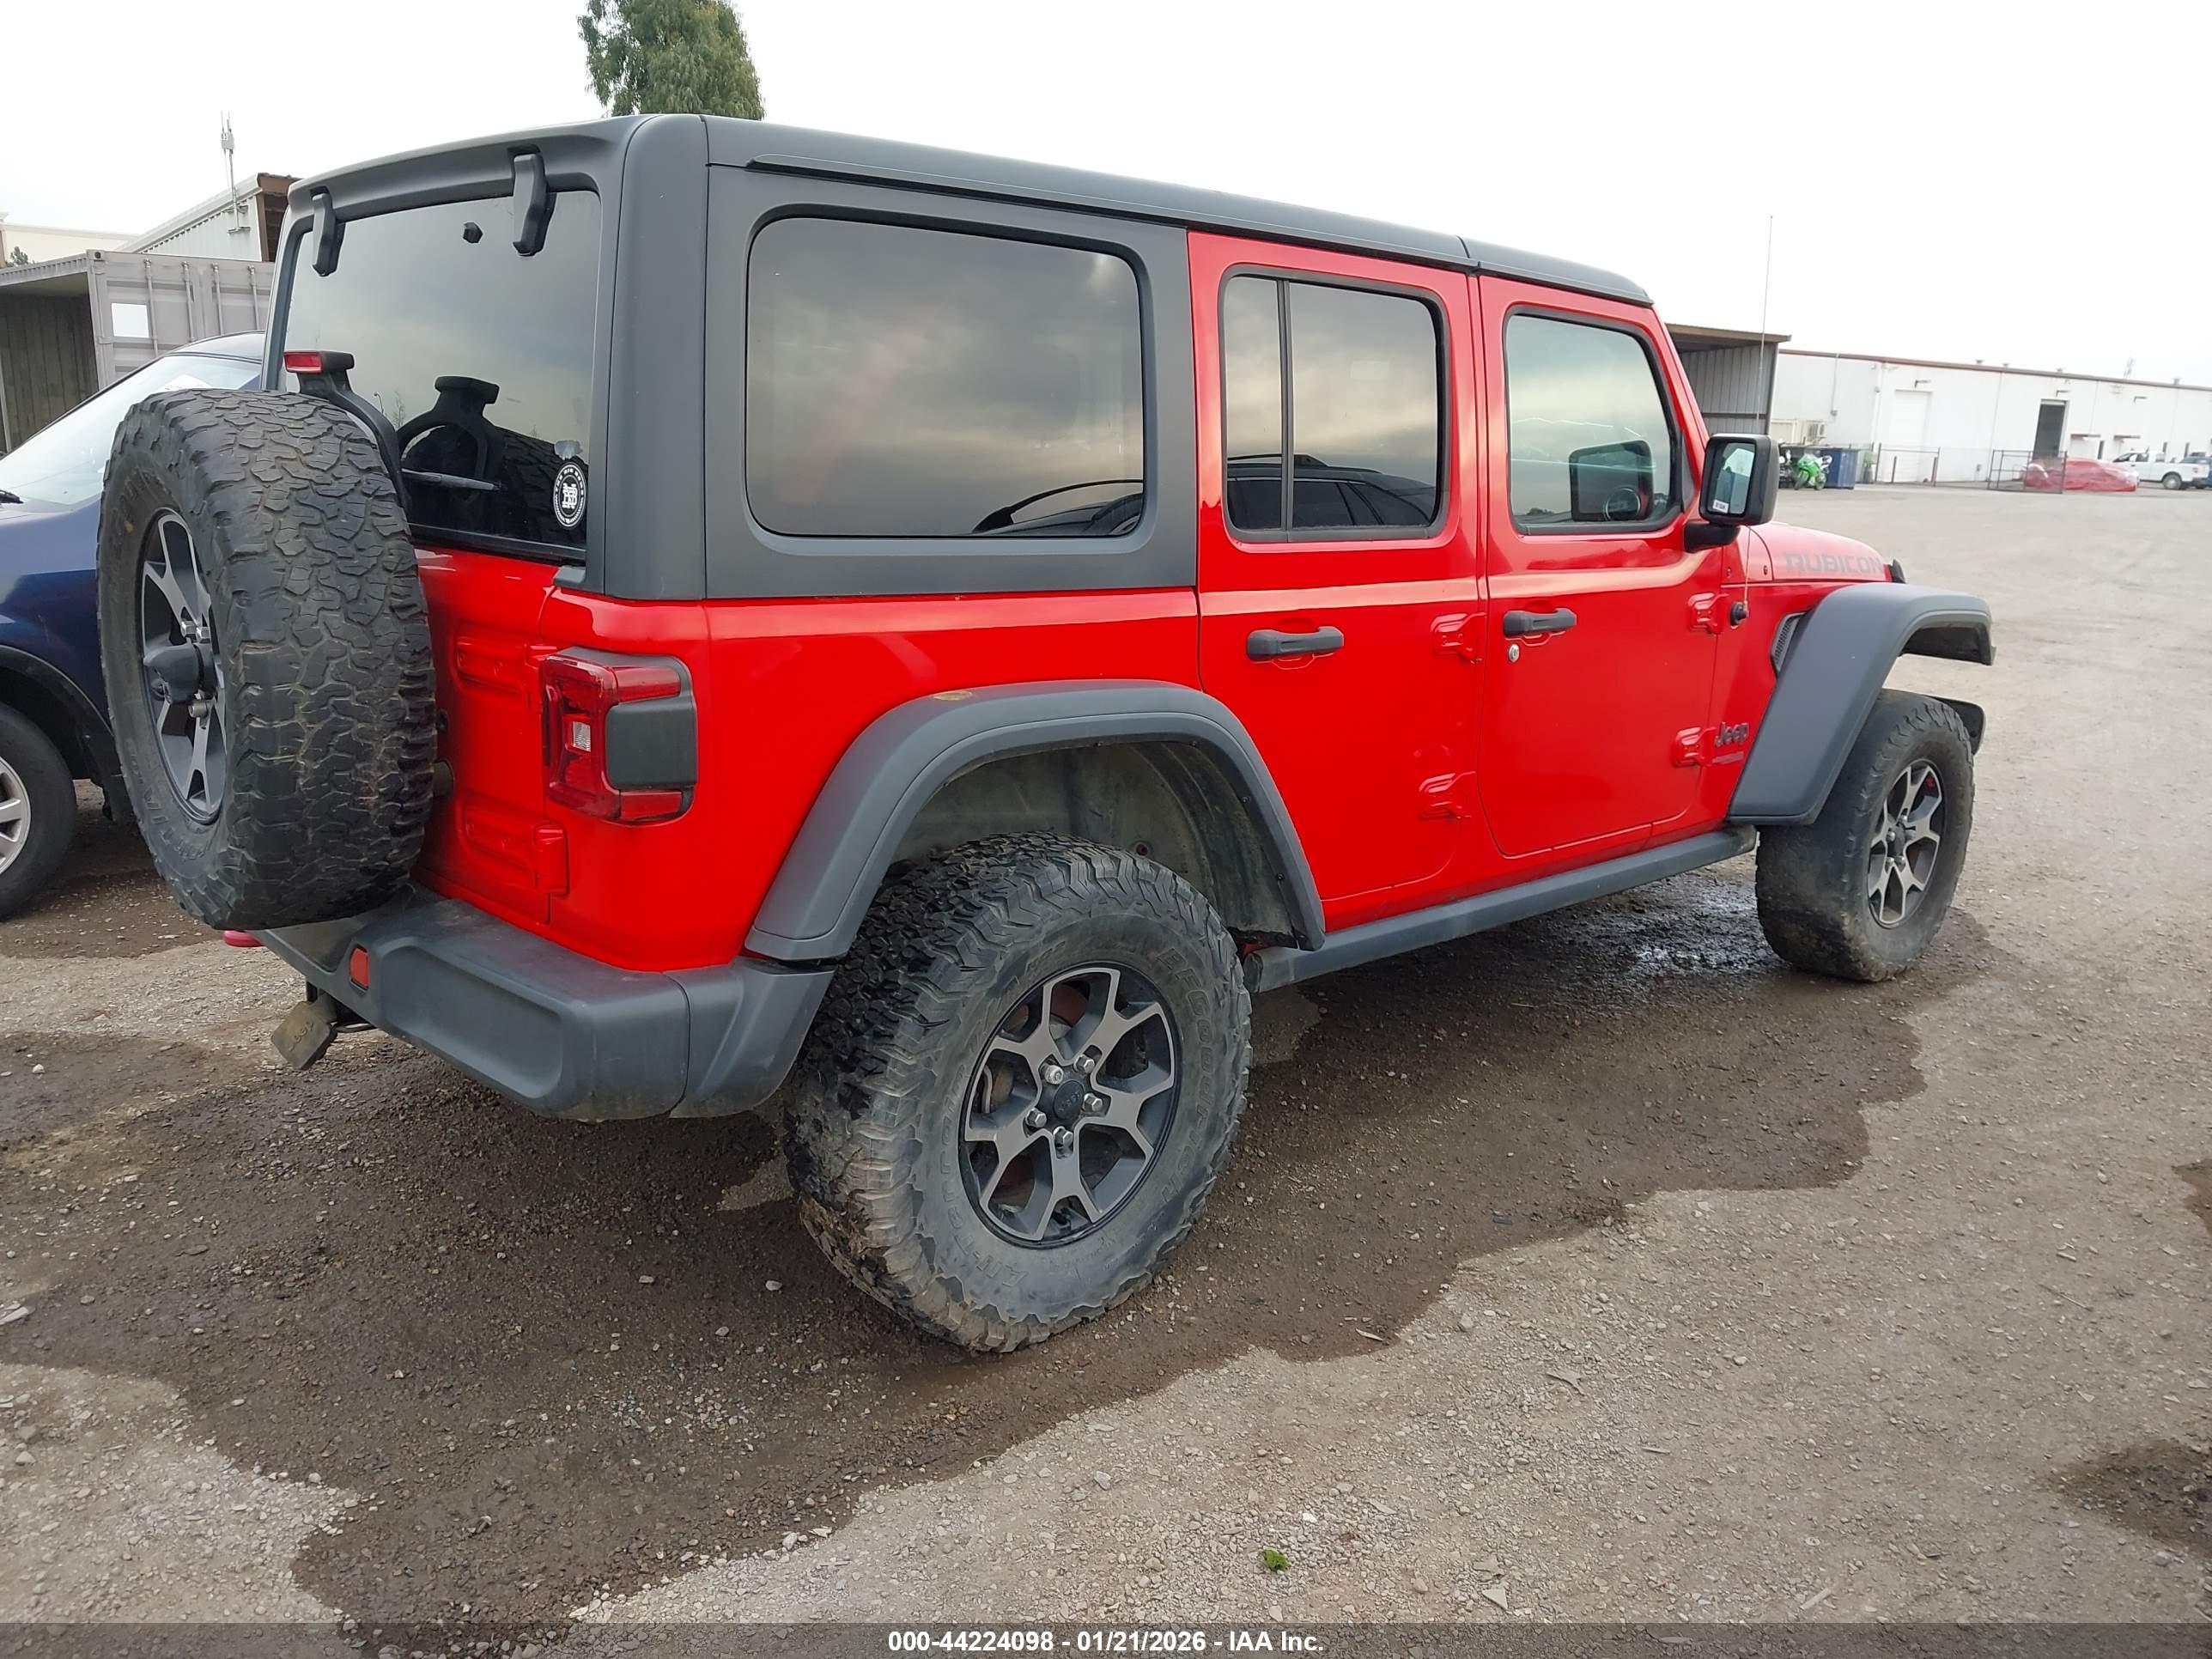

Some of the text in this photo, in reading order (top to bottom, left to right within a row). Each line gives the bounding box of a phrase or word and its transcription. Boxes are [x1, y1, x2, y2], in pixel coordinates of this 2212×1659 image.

[1784, 552, 1883, 574] RUBICON
[1714, 721, 1749, 747] Jeep
[1154, 947, 1213, 1204] BFGoodrich
